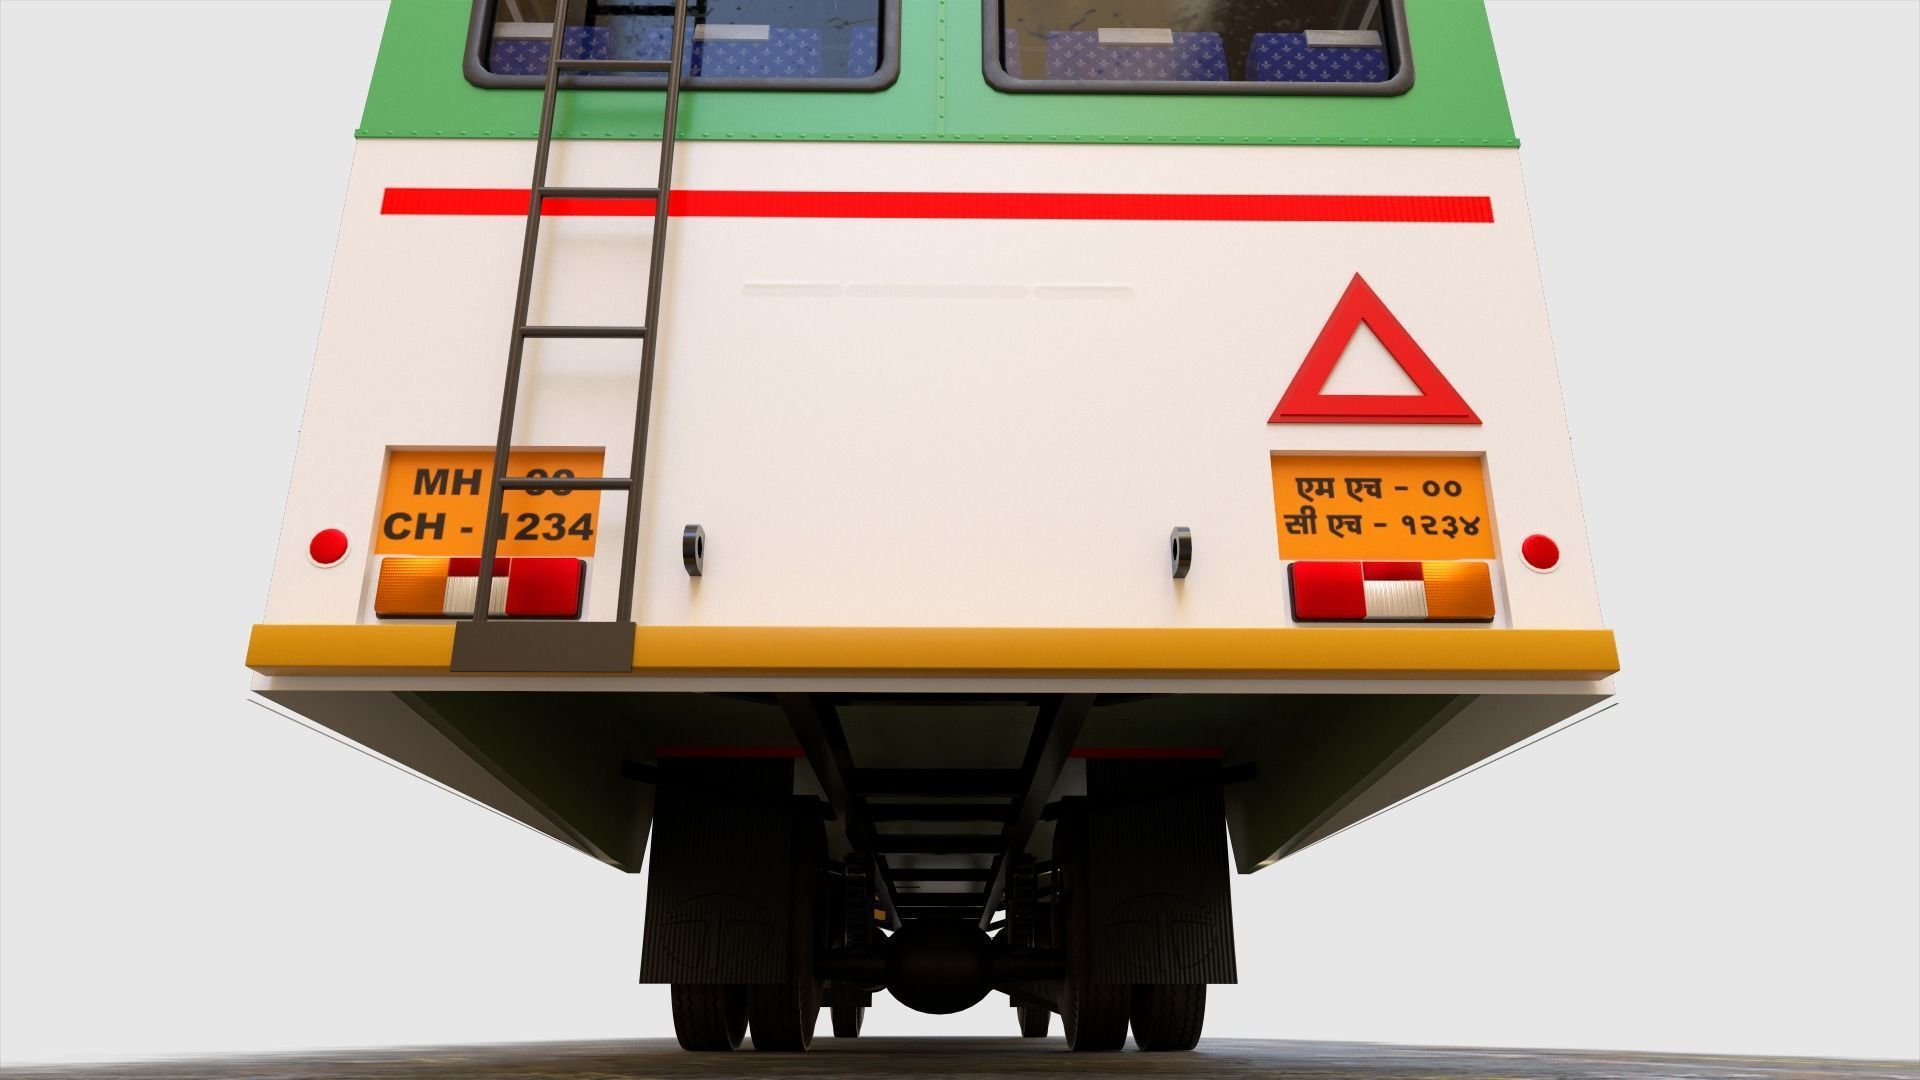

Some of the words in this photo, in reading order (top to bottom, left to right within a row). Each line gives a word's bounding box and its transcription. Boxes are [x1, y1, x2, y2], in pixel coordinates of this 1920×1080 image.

[413, 468, 482, 496] MH
[1295, 477, 1335, 502] एम
[1344, 477, 1383, 502] एच
[383, 512, 446, 540] CH
[497, 512, 594, 541] 1234
[1284, 505, 1318, 535] सी
[1327, 514, 1362, 539] एच
[1401, 514, 1481, 539] १२३४
